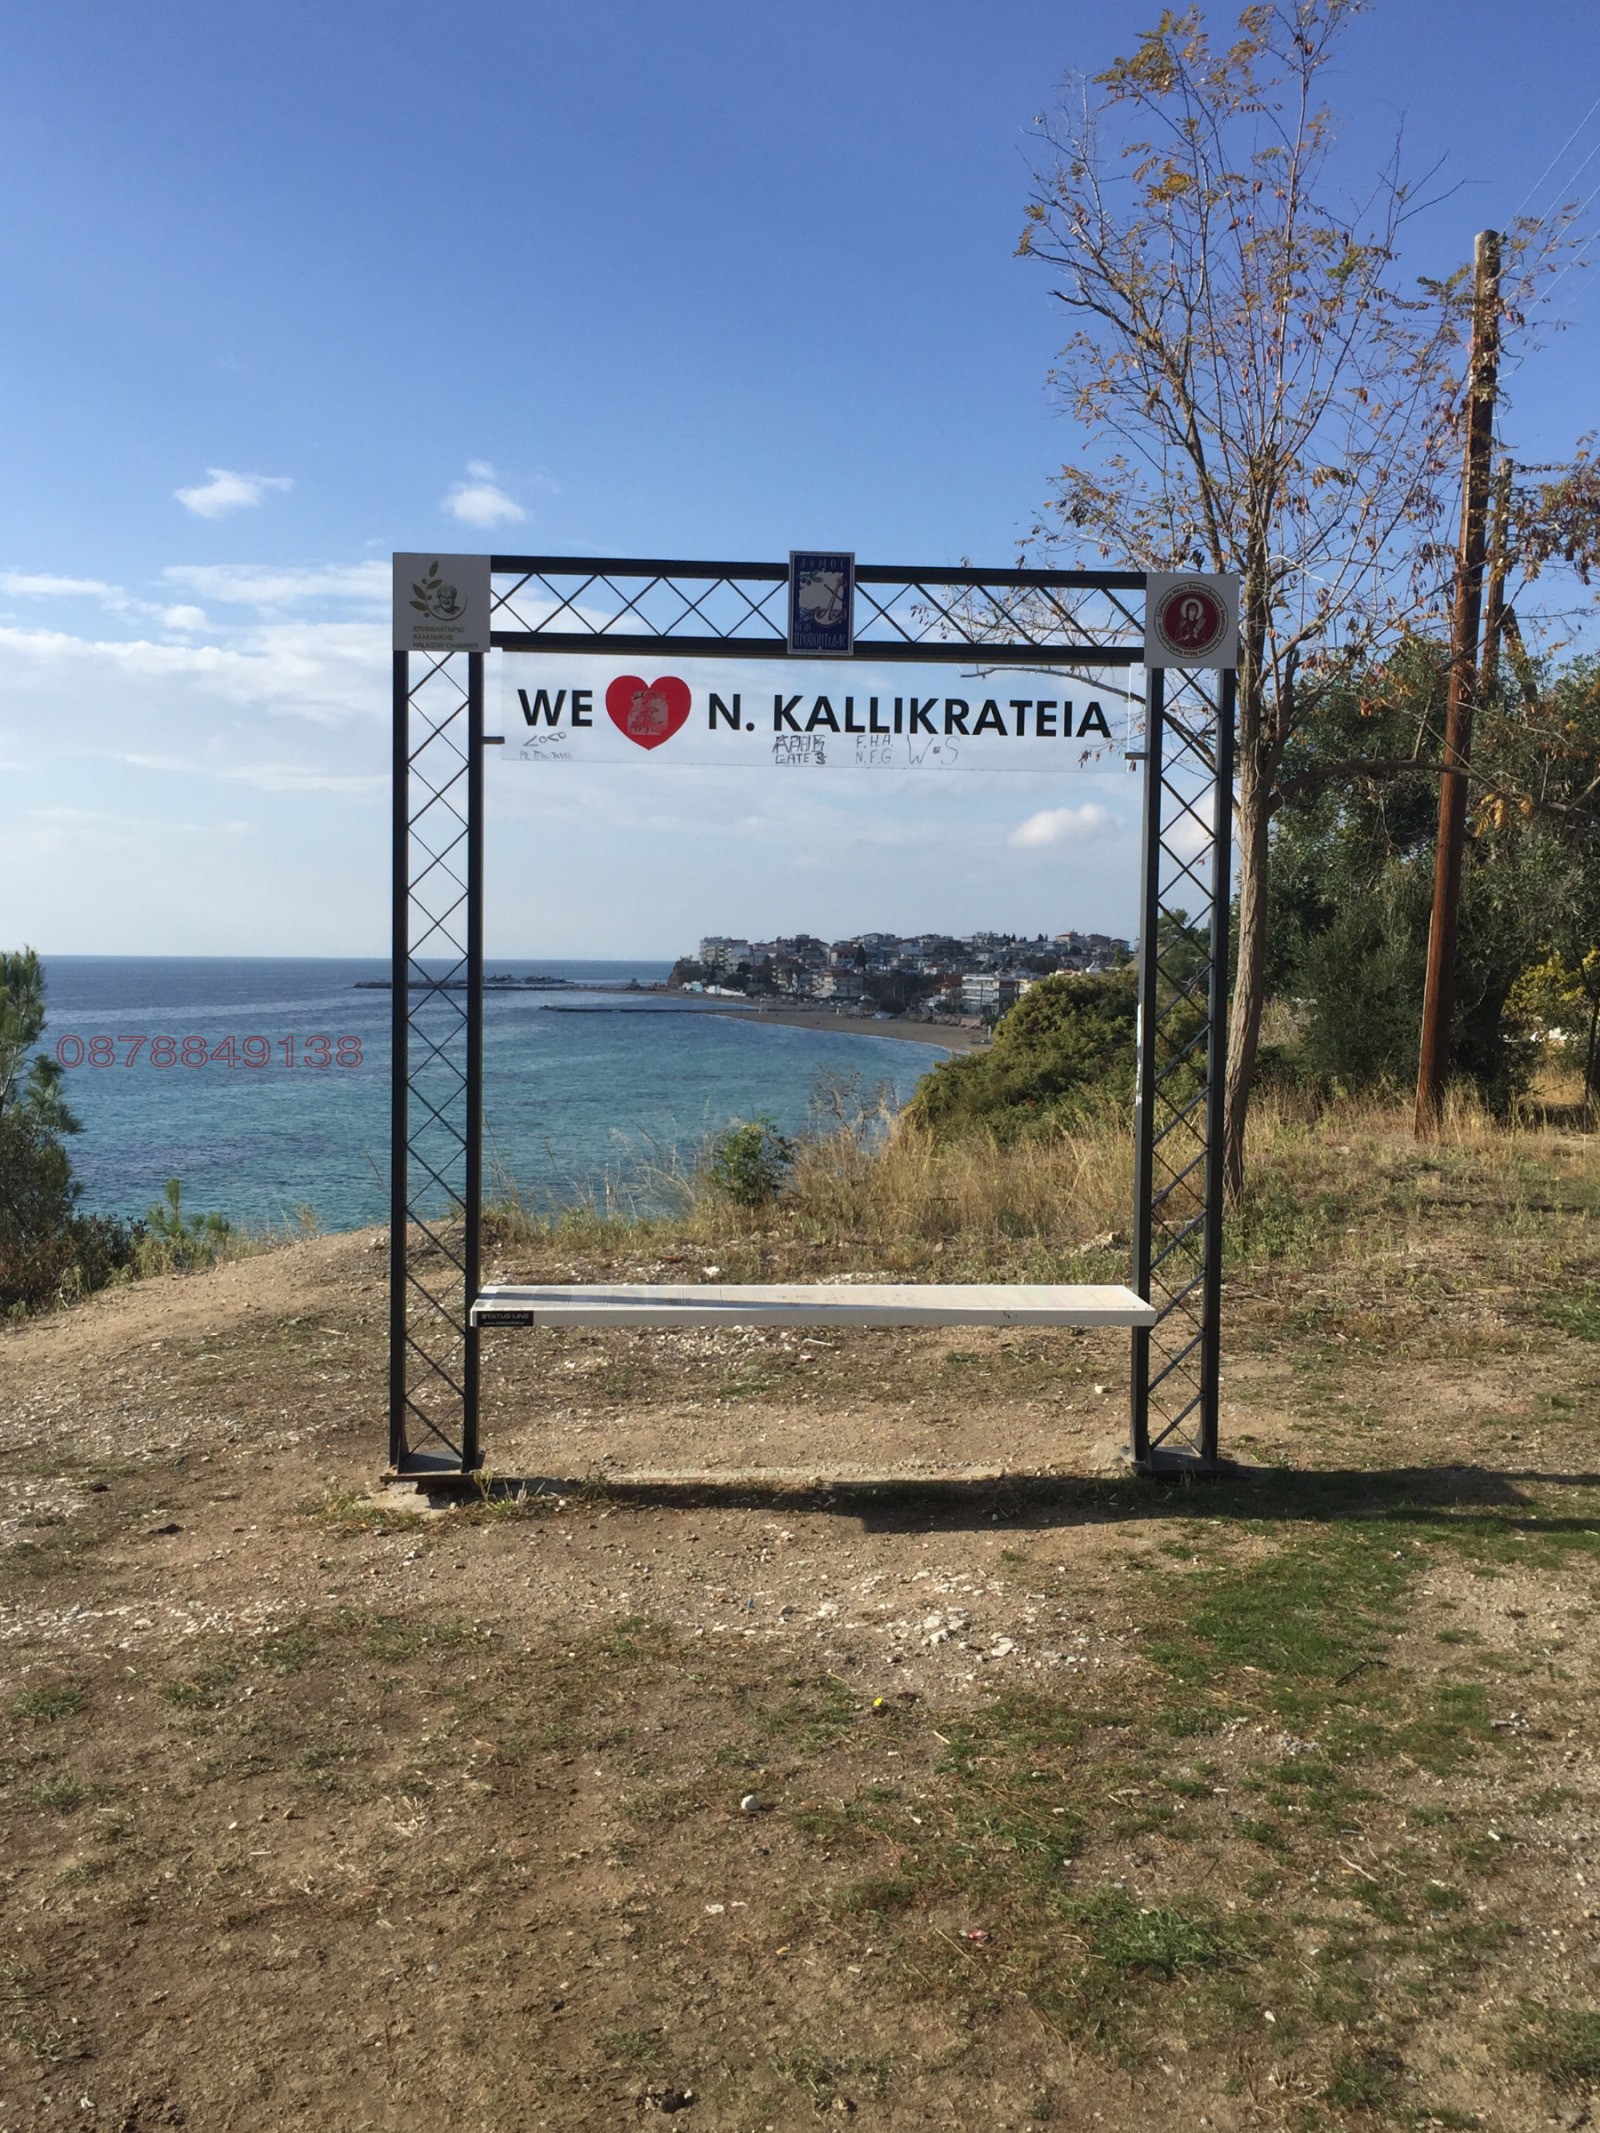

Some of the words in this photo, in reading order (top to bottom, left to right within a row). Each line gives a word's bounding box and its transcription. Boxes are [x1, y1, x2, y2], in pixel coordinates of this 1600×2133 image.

[517, 689, 593, 727] WE
[708, 693, 755, 731] N.
[773, 694, 1112, 738] KALLIKRATEIA
